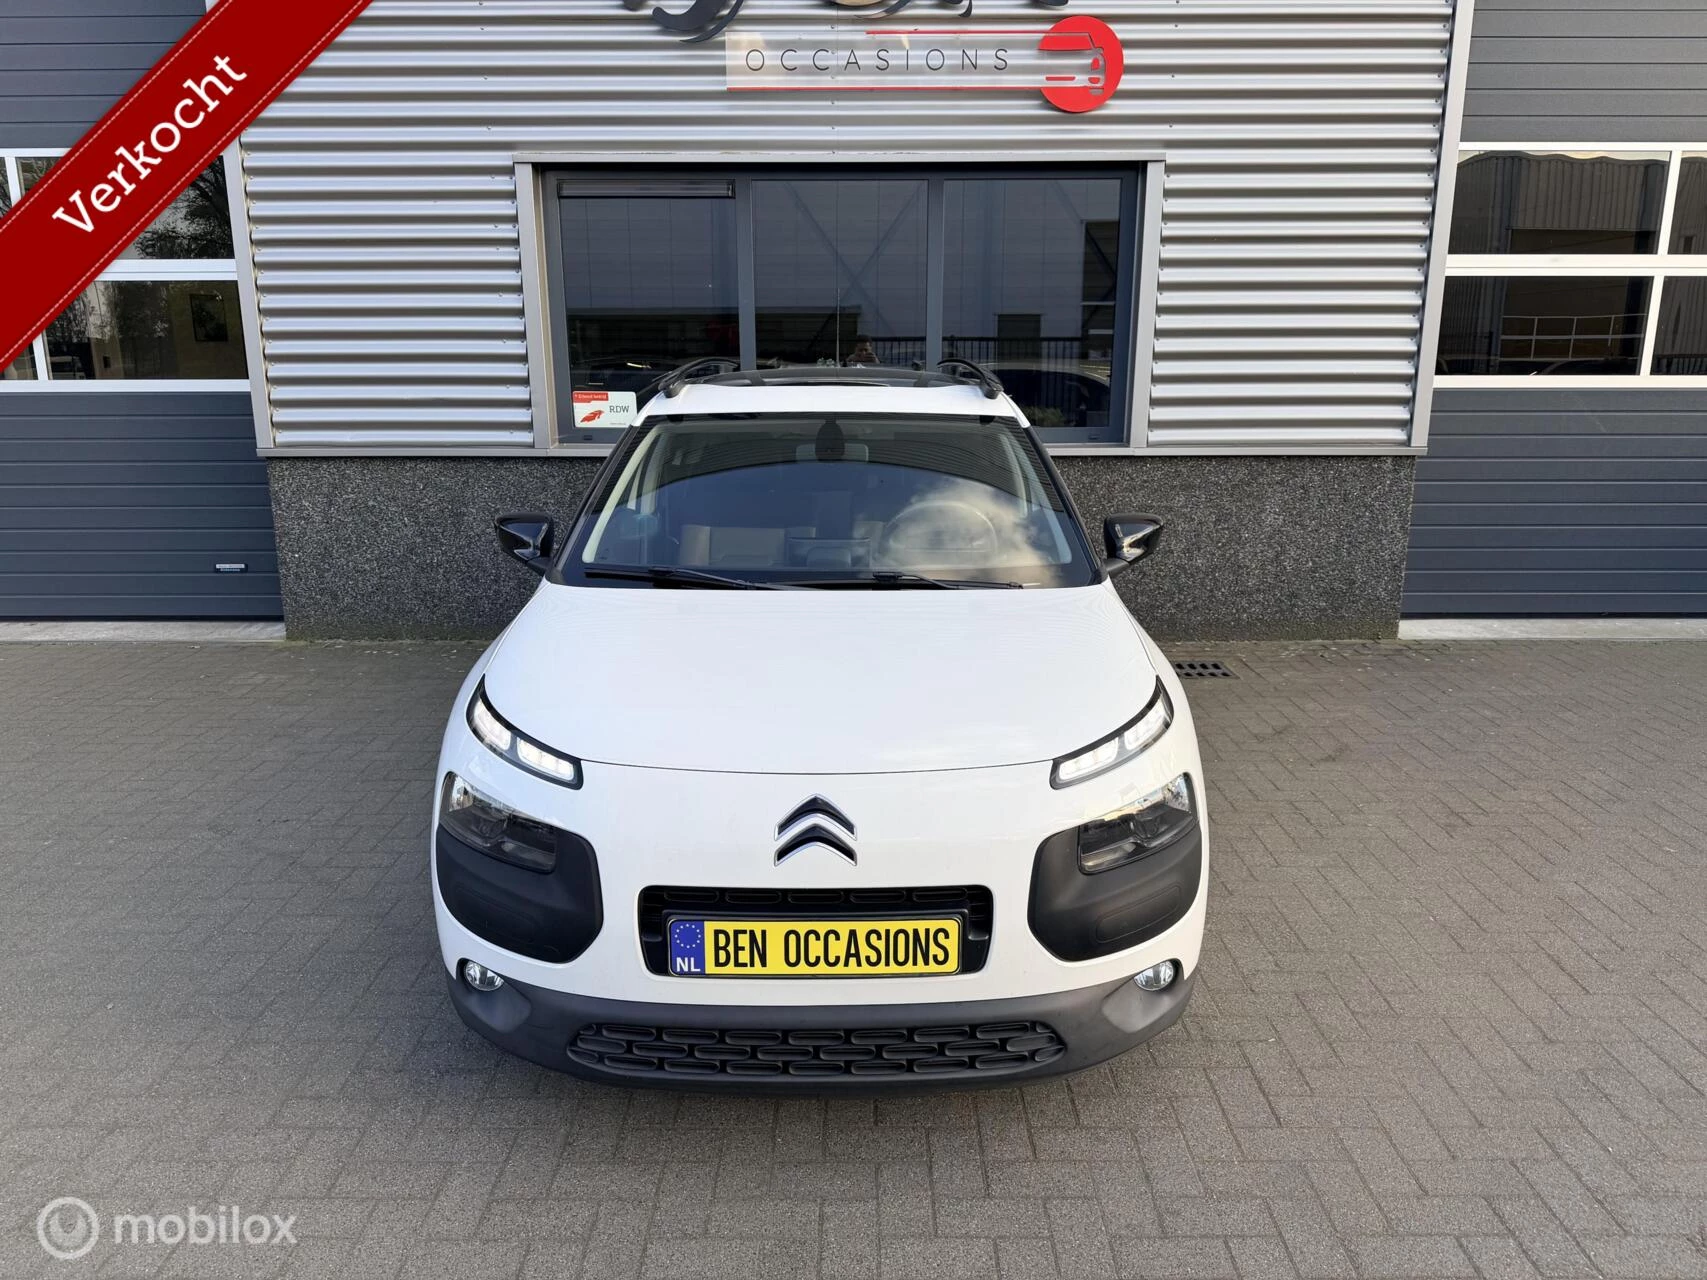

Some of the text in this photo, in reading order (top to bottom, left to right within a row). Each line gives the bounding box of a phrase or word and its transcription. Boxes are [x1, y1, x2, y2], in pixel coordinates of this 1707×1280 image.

[745, 47, 1009, 73] OCCASIONS
[609, 405, 630, 414] RDW
[713, 927, 950, 969] BEN OCCASIONS
[676, 957, 701, 973] NL
